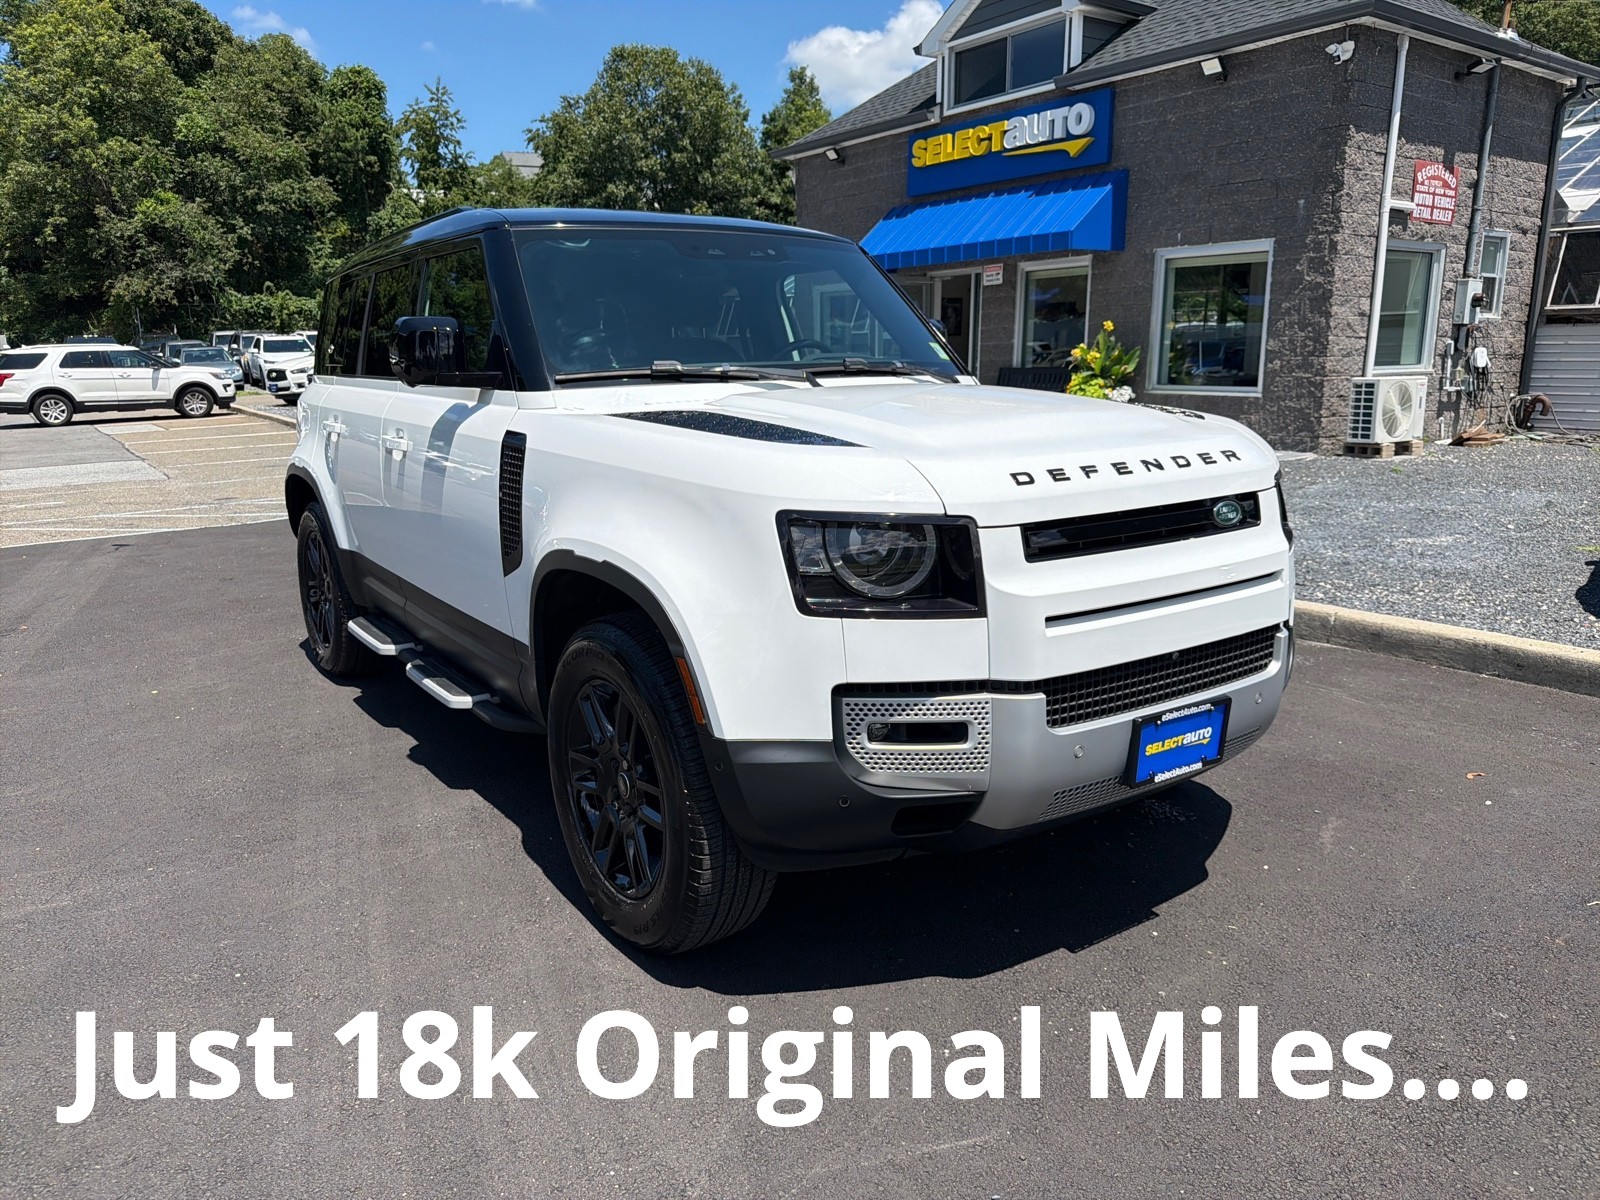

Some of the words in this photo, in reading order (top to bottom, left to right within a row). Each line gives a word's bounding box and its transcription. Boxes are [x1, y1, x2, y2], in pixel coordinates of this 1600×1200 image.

[1417, 164, 1457, 188] REGISTERED
[1416, 184, 1429, 192] STATE
[1414, 192, 1434, 206] MOTOR
[1434, 196, 1456, 209] VEHICLE
[1413, 206, 1432, 219] RETAIL
[1432, 208, 1453, 222] DEALER
[1009, 449, 1242, 487] DEFENDER
[1161, 703, 1212, 722] eSelectAuto.com
[1154, 762, 1203, 783] eSelectAuto.com
